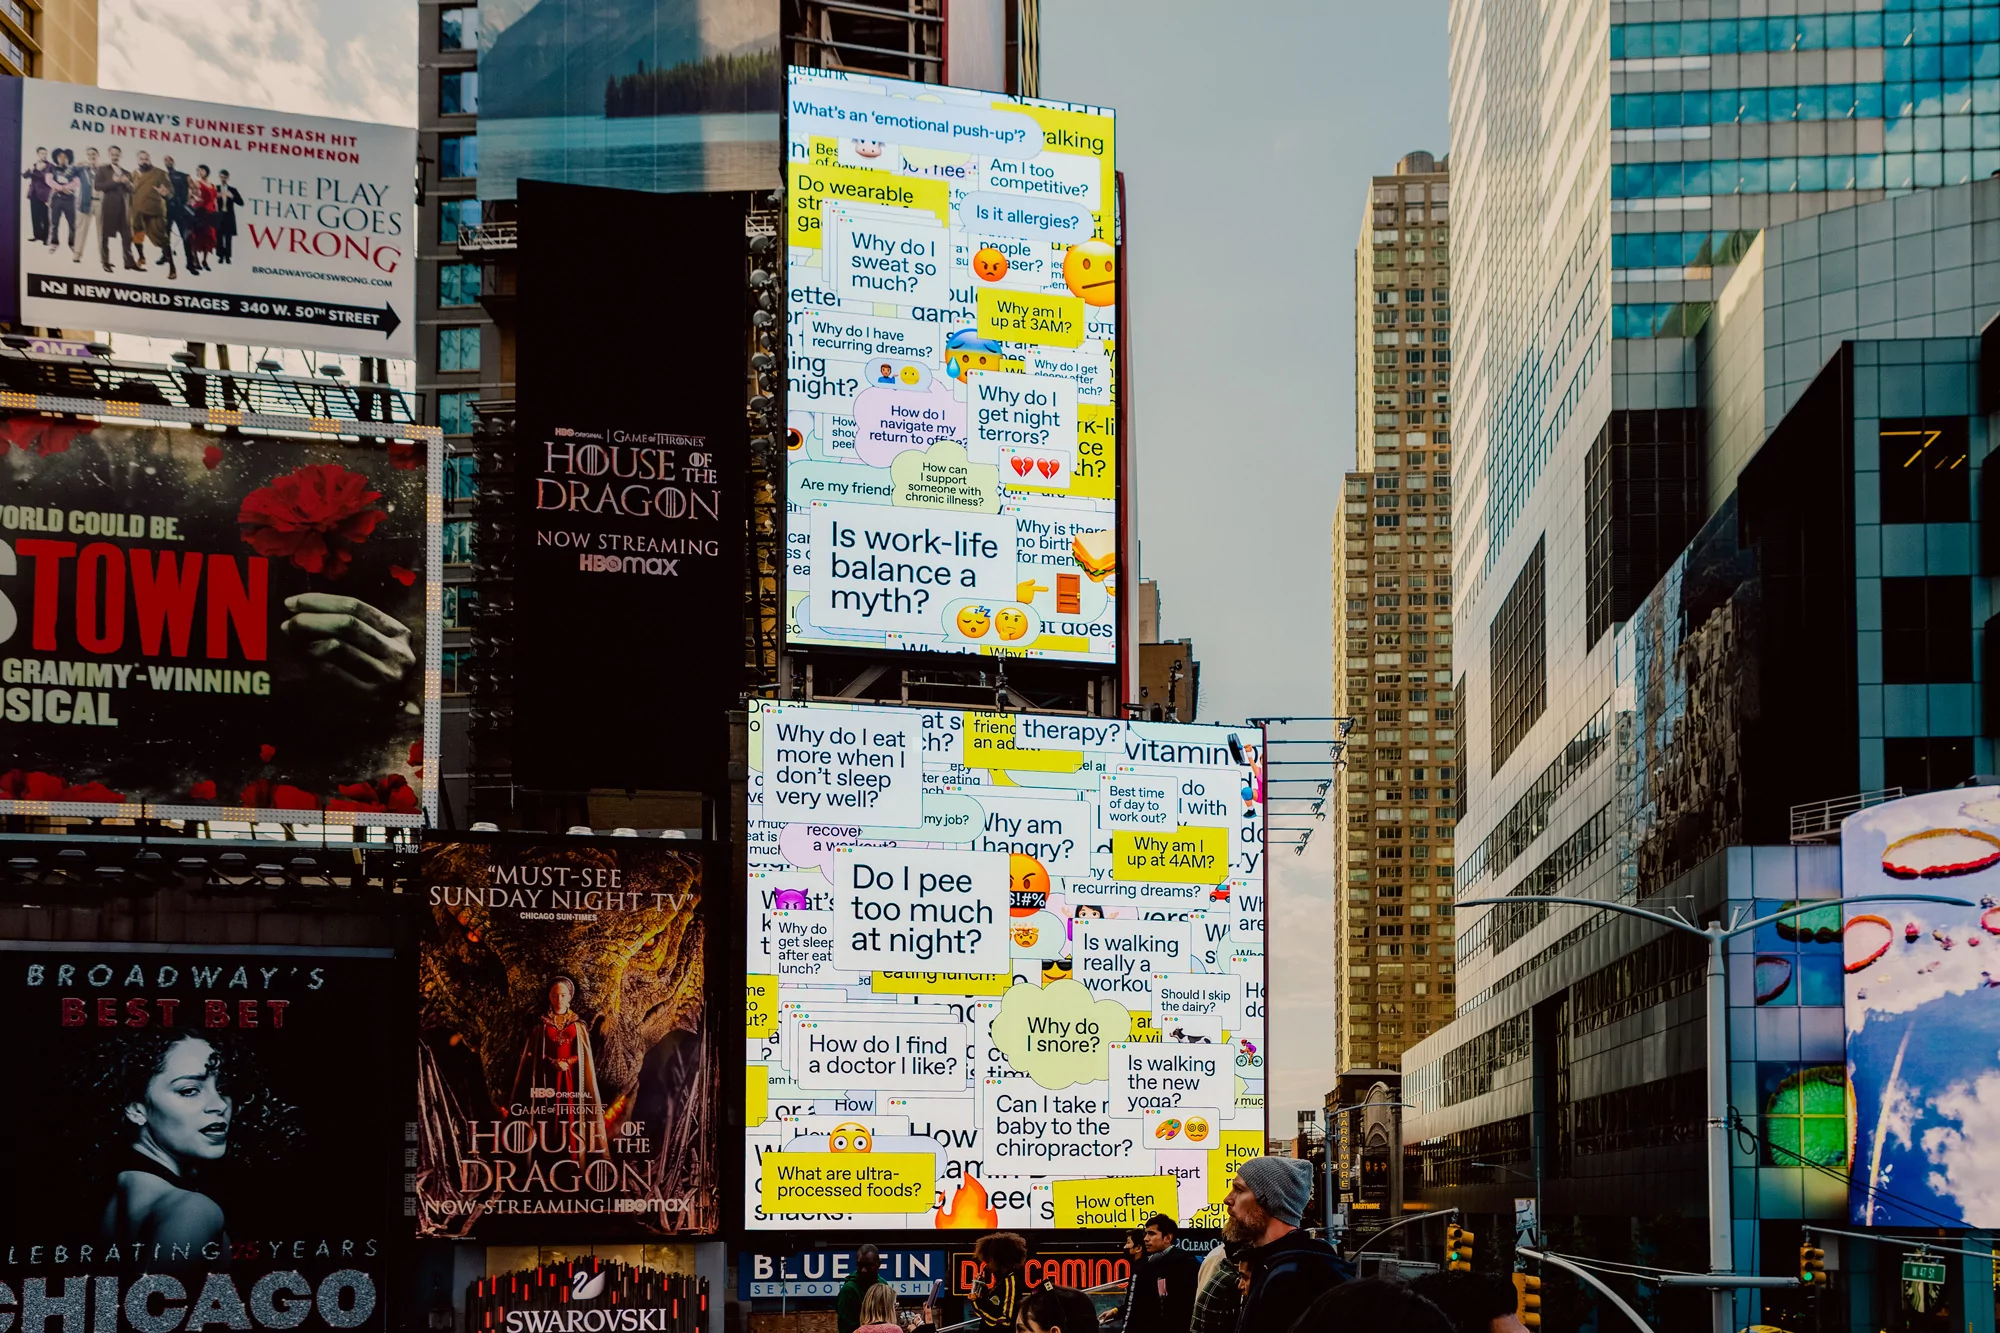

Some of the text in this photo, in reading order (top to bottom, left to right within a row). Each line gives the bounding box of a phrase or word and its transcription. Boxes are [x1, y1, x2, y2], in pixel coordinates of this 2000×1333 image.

[850, 110, 867, 122] an
[71, 119, 359, 164] AND INTERNATIONAL PHENOMENON
[186, 117, 265, 137] FUNNIEST
[271, 127, 327, 145] SMASH
[332, 133, 357, 147] HIT
[262, 177, 390, 207] THE PLAY
[249, 198, 401, 235] THAT GOES
[977, 205, 989, 220] Is
[993, 207, 1003, 221] it
[1008, 210, 1079, 229] allergies?
[248, 224, 401, 274] WRONG
[852, 232, 896, 255] Why
[901, 239, 925, 255] do
[252, 266, 392, 287] BROADWAYGOESWRONG.COM
[852, 255, 936, 276] sweat so
[852, 275, 918, 292] much?
[73, 283, 380, 325] NEW WORLD STAGES 340 W. 50TH STREET
[979, 385, 1020, 407] Why
[1024, 390, 1047, 405] do
[979, 407, 1060, 429] get night
[555, 427, 575, 437] HBO
[614, 430, 647, 443] GAME
[654, 433, 705, 447] THRONES
[978, 425, 1049, 445] terrors?
[544, 442, 712, 481] HOUSE OF
[922, 462, 968, 475] How can
[682, 468, 717, 484] THE
[926, 474, 967, 486] support
[536, 478, 721, 521] DRAGON
[906, 492, 984, 506] chronic illness?
[908, 484, 982, 497] someone with
[0, 505, 184, 540] ORLD COULD BE.
[537, 530, 719, 556] NOW STREAMING
[832, 521, 998, 559] Is work-life
[832, 552, 976, 587] balance a
[832, 588, 929, 617] myth?
[1022, 719, 1120, 746] therapy?
[1110, 786, 1164, 799] Best time
[1110, 799, 1159, 812] of day to
[1110, 813, 1166, 823] work out?
[395, 844, 418, 854] TS-7022
[1134, 837, 1169, 854] Why
[1172, 841, 1196, 852] am
[1127, 855, 1215, 869] up at 4AM?
[854, 864, 894, 889] Do
[920, 874, 972, 898] pee
[430, 886, 541, 908] SUNDAY
[552, 890, 643, 911] NIGHT
[520, 911, 555, 921] CHICAGO
[851, 896, 993, 924] too much
[852, 928, 982, 960] at night?
[1161, 989, 1200, 1000] Should
[1208, 990, 1231, 1003] skip
[61, 998, 290, 1029] BEST BET
[1161, 1002, 1216, 1014] the dairy?
[1027, 1017, 1099, 1038] Why do
[1037, 1036, 1100, 1053] snore?
[530, 1088, 555, 1098] HBO
[997, 1094, 1036, 1113] Can
[1053, 1096, 1096, 1113] take
[511, 1103, 546, 1116] GAME
[554, 1104, 608, 1116] THRONES
[467, 1120, 645, 1154] HOUSE OF
[997, 1117, 1109, 1139] baby to the
[613, 1137, 650, 1155] THE
[996, 1139, 1133, 1161] chiropractor?
[1340, 1110, 1349, 1188] BARRYMORE
[460, 1159, 654, 1194] DRAGON
[778, 1166, 899, 1181] What are ultra-
[778, 1182, 922, 1200] processed foods?
[425, 1200, 482, 1215] NOW
[484, 1199, 604, 1215] STREAMING
[269, 1238, 378, 1258] YEARS
[754, 1254, 849, 1279] BLUE
[0, 1269, 376, 1333] HICAGO
[506, 1309, 666, 1333] SWAROVSKI
